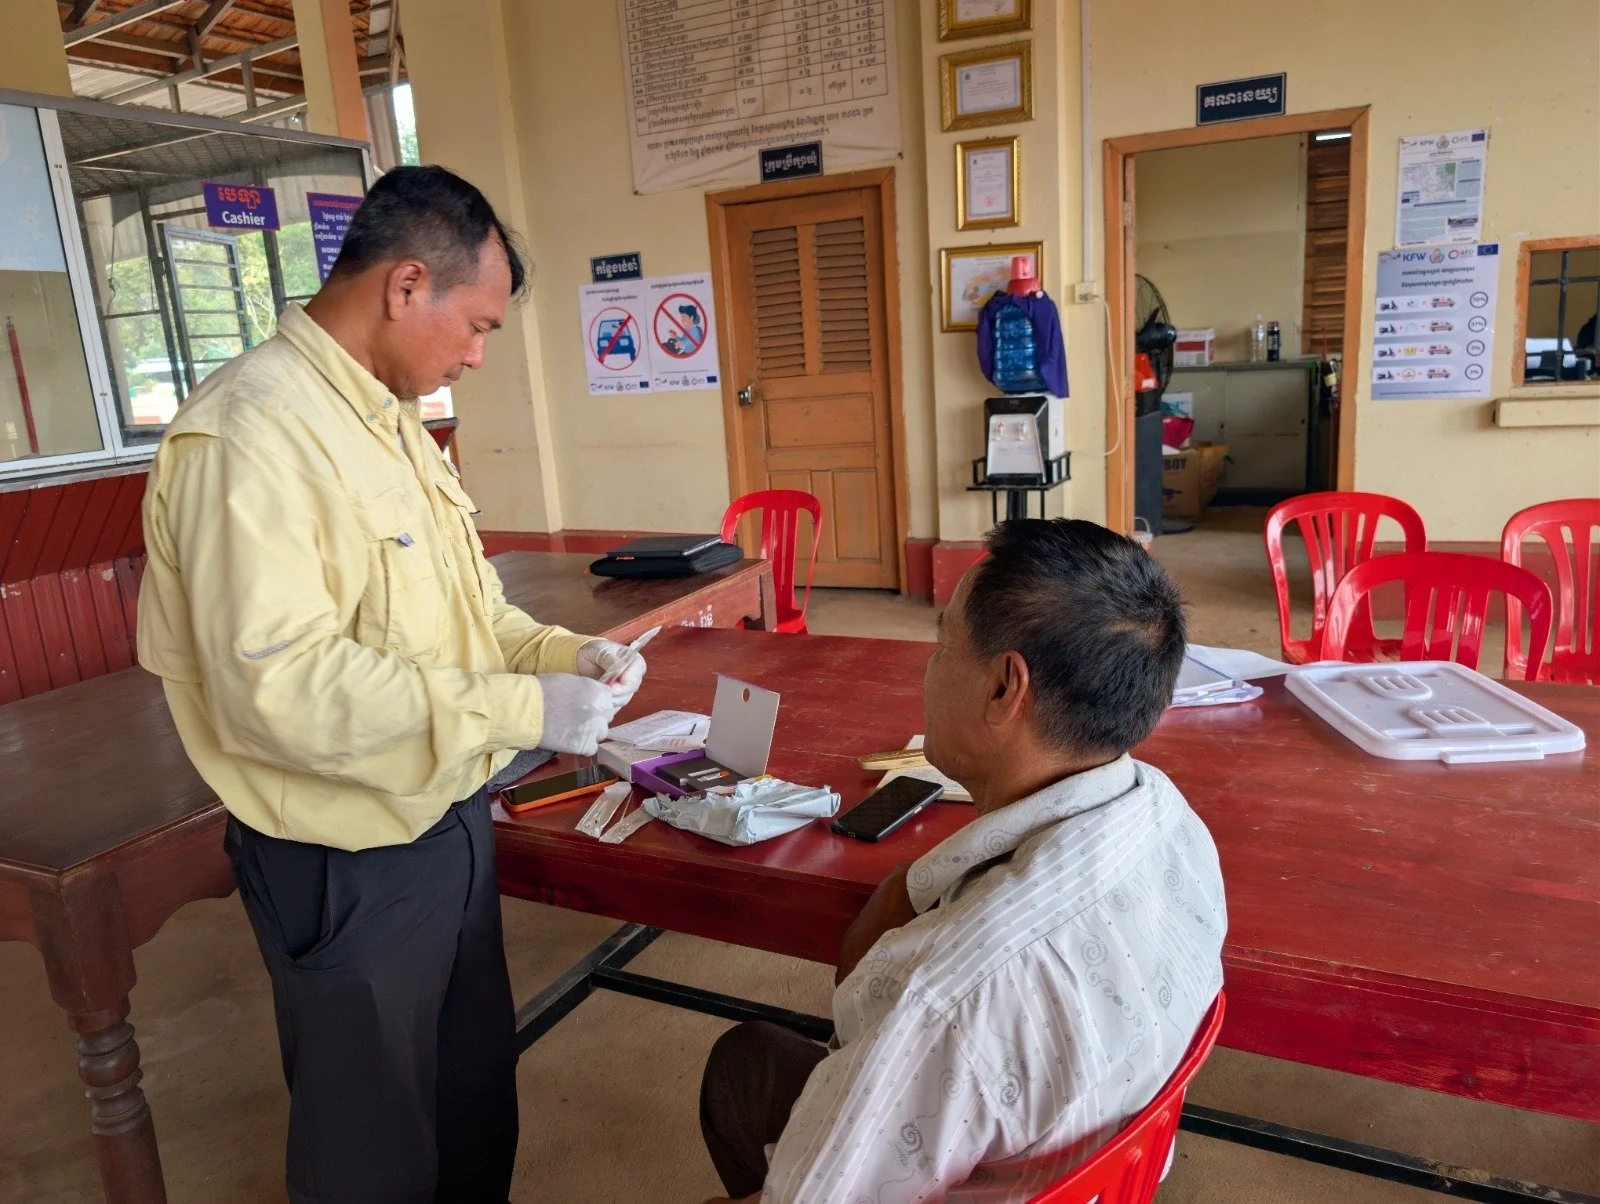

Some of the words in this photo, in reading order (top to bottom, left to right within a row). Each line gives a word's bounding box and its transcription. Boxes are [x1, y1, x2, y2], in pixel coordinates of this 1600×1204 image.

[1203, 86, 1278, 108] គណនេយ្យ
[217, 187, 261, 210] បេឡា
[221, 211, 266, 226] Cashier
[1402, 252, 1427, 262] KFW
